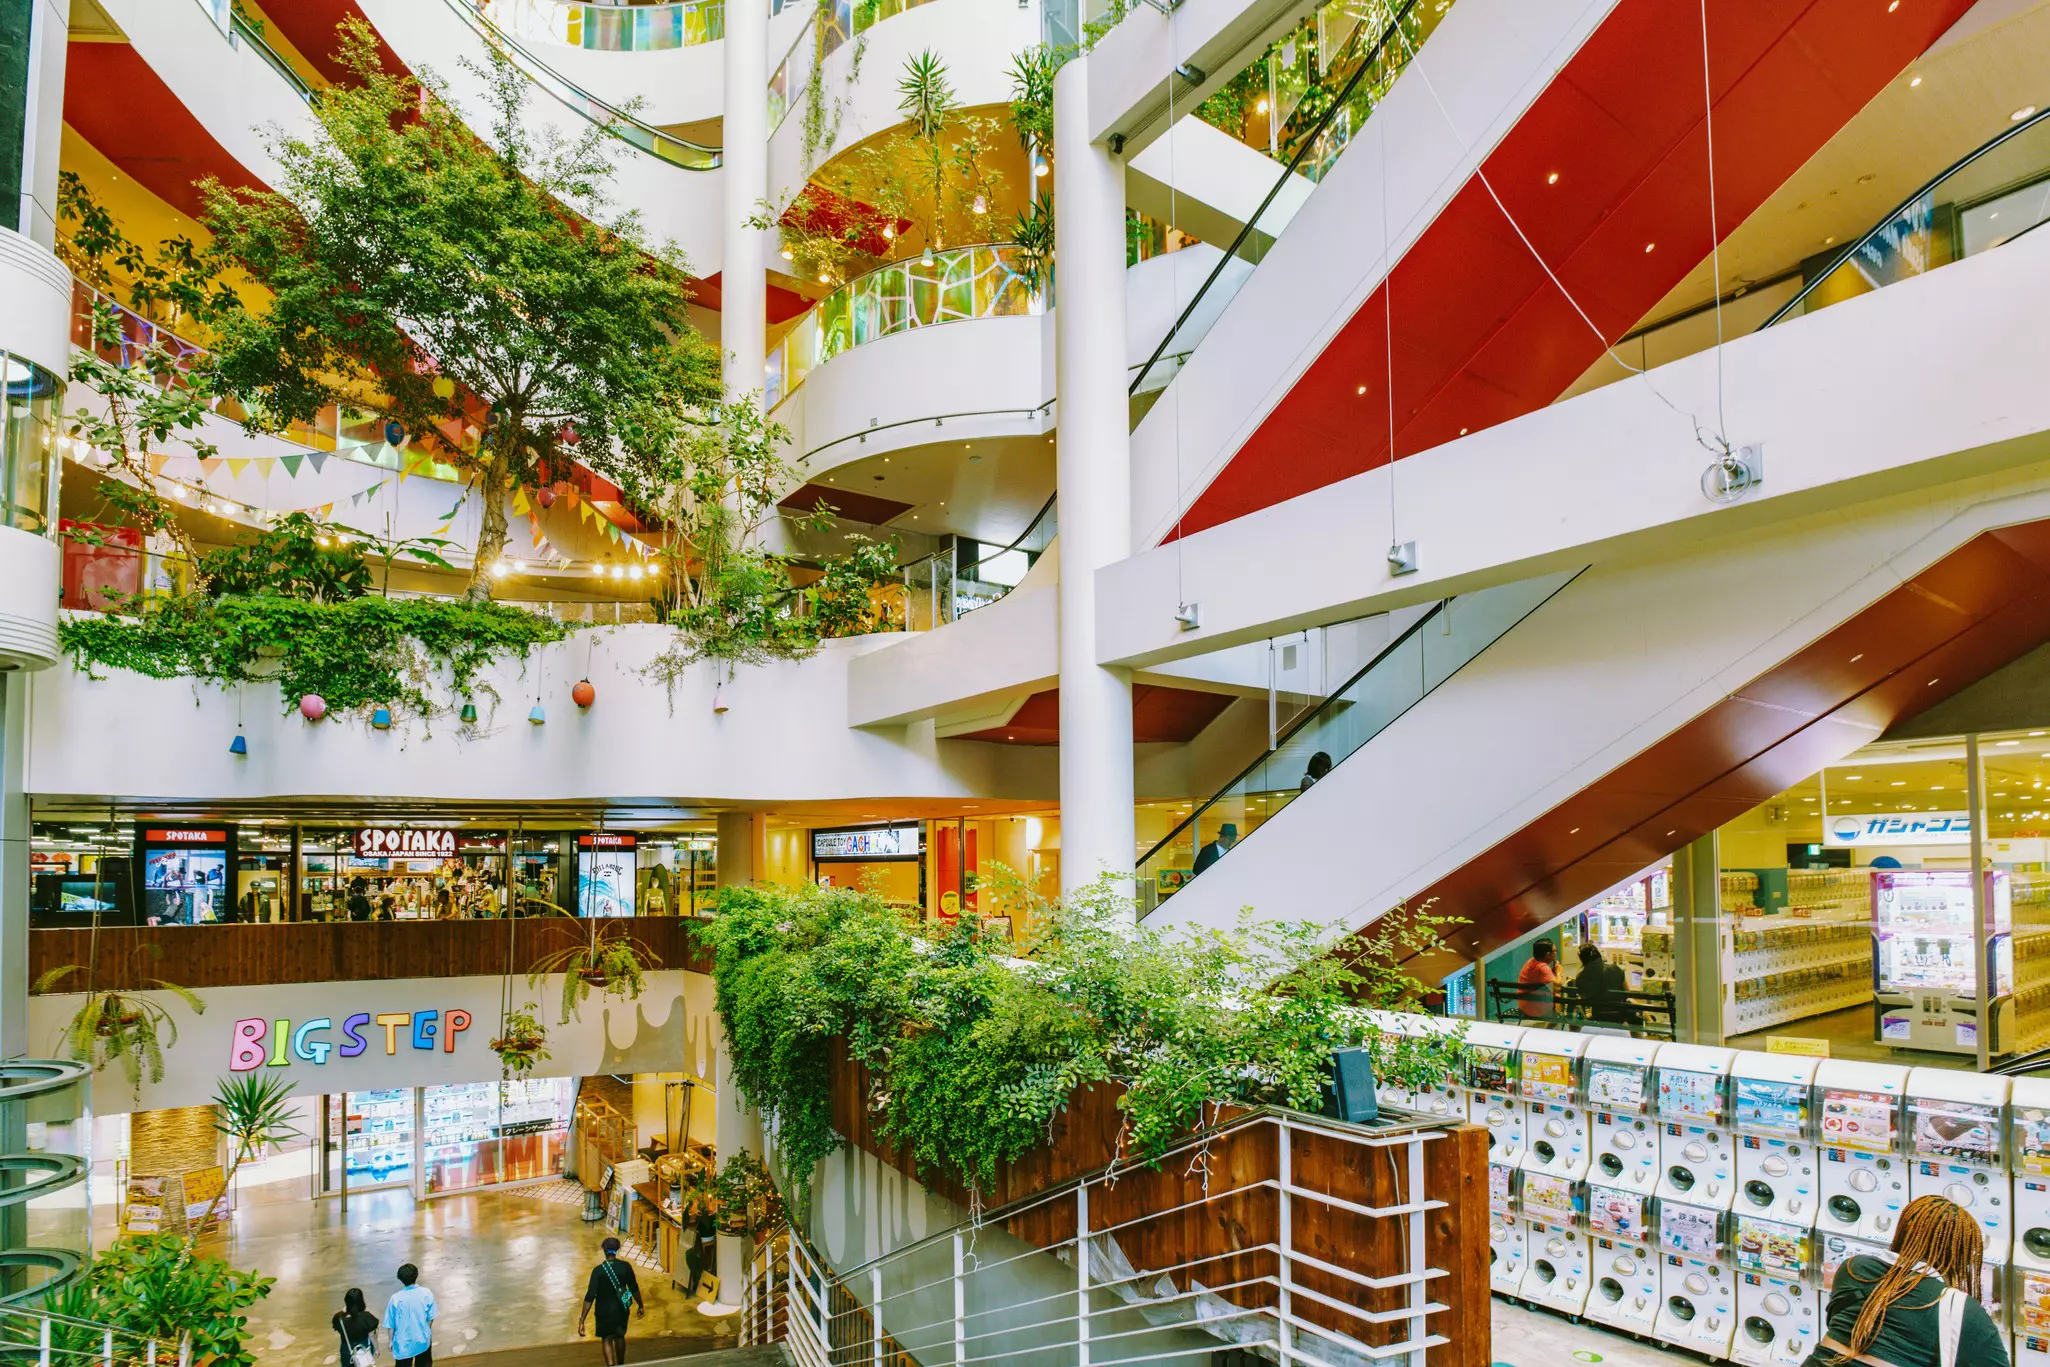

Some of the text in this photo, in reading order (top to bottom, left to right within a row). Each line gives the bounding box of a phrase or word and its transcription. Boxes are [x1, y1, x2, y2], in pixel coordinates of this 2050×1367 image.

[166, 831, 208, 841] SPOTAKA
[360, 828, 456, 851] SPOTAKA
[593, 836, 623, 845] SPOTAKA
[817, 837, 836, 847] CAPSULE
